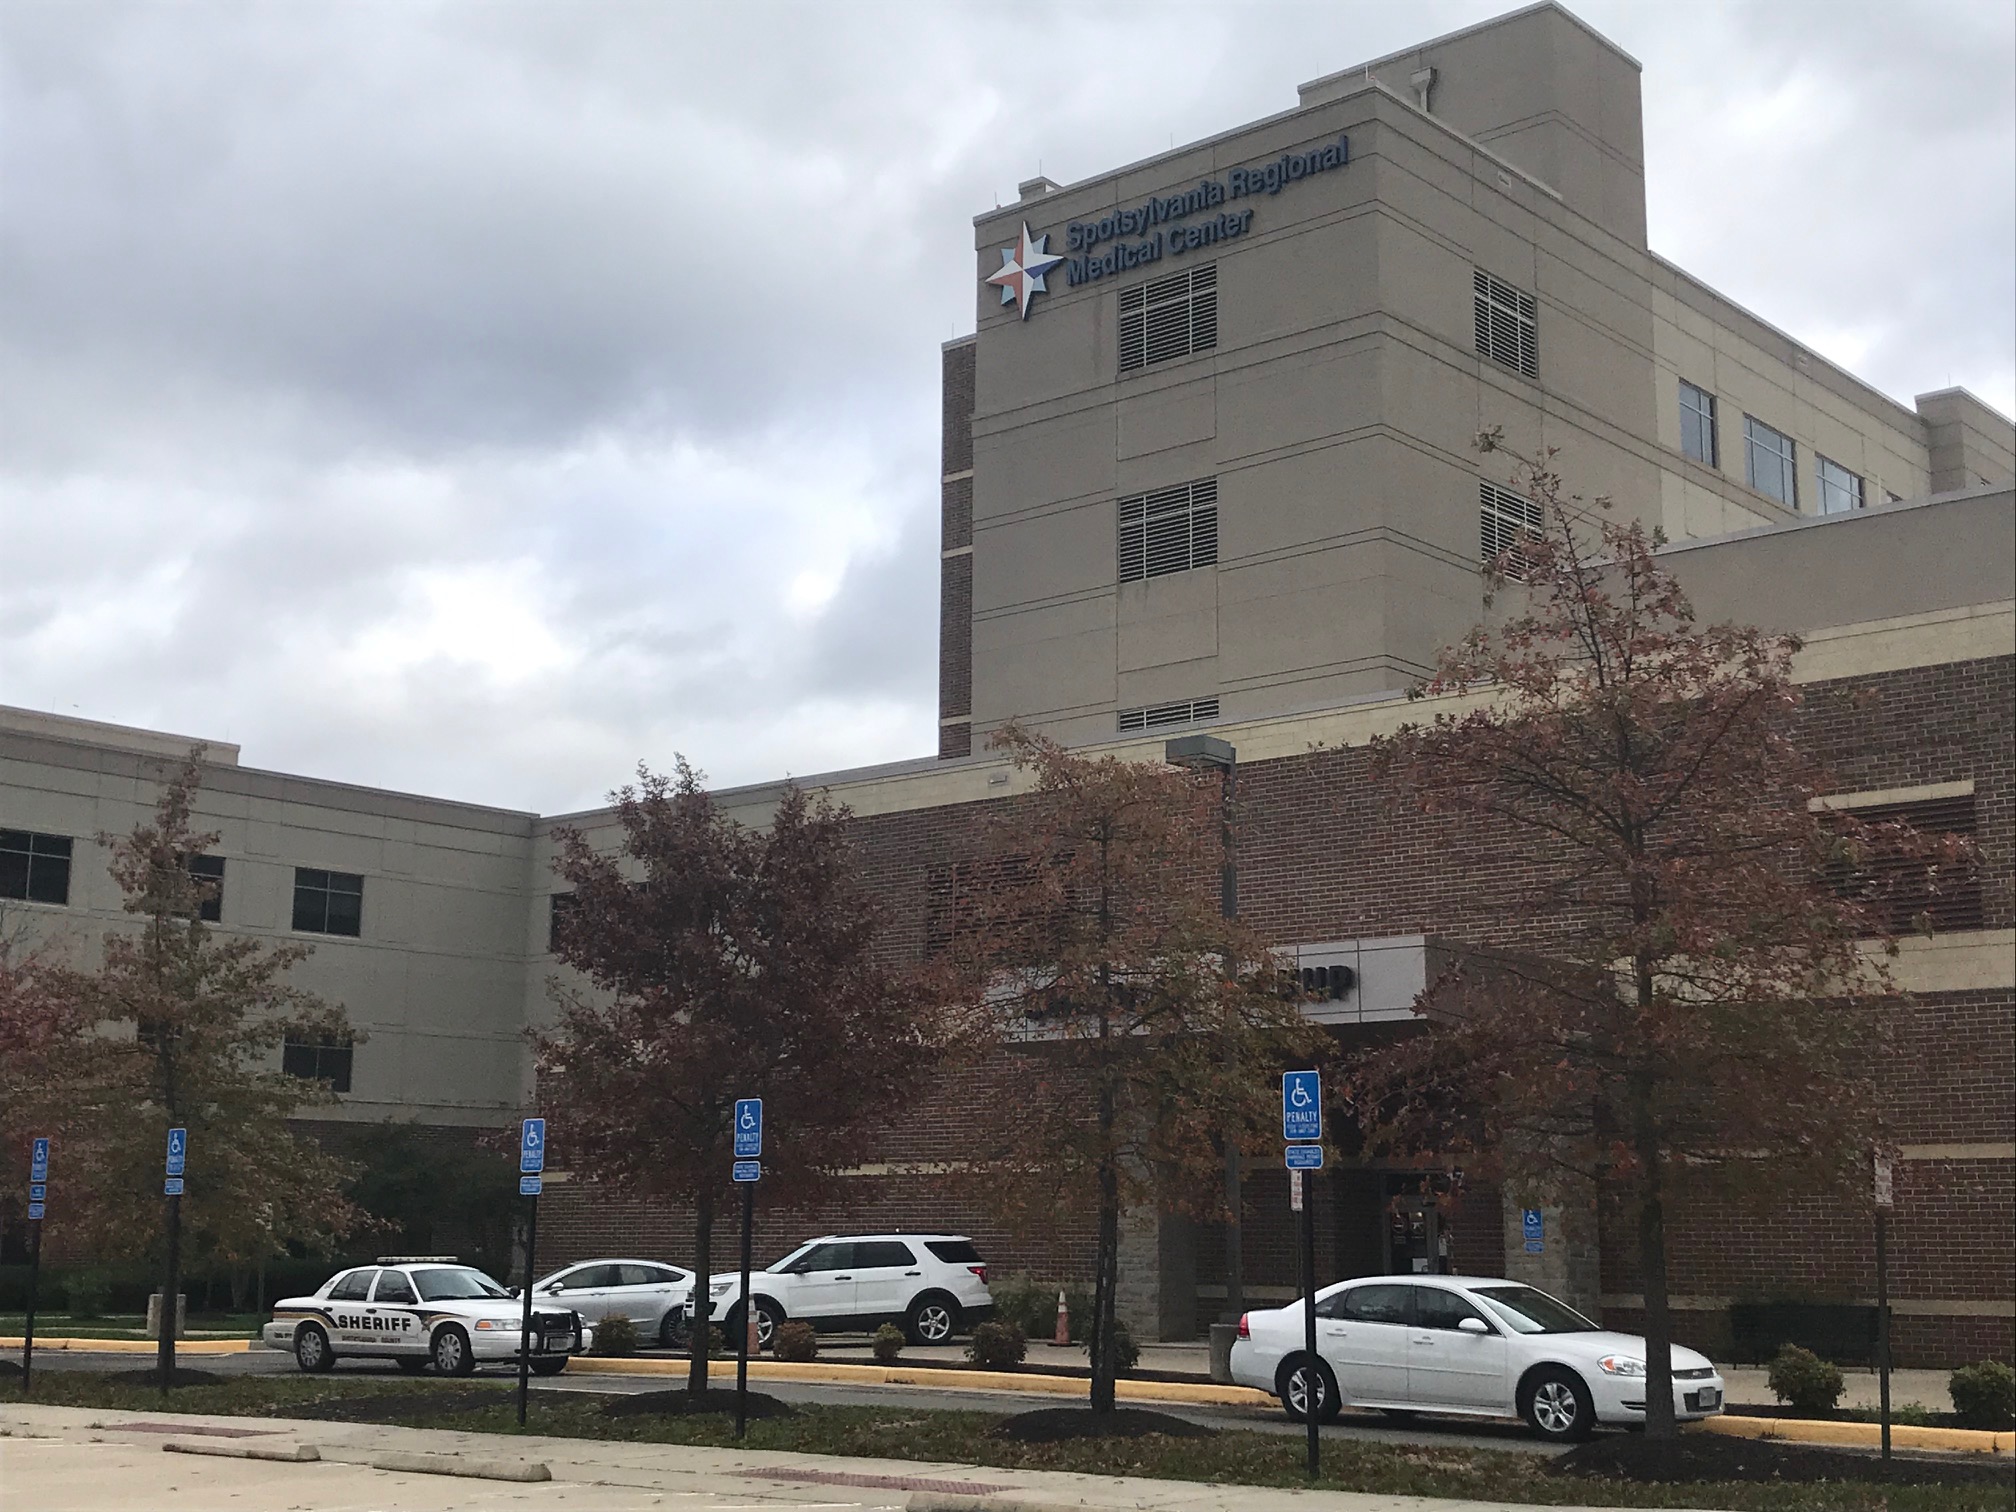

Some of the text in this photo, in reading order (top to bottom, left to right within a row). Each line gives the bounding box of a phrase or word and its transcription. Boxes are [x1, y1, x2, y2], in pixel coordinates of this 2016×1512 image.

[1065, 134, 1350, 251] Spotsylvania Regional
[1065, 207, 1254, 287] Medical Center
[1286, 1110, 1318, 1123] PENALTY
[338, 1314, 412, 1332] SHERIFF
